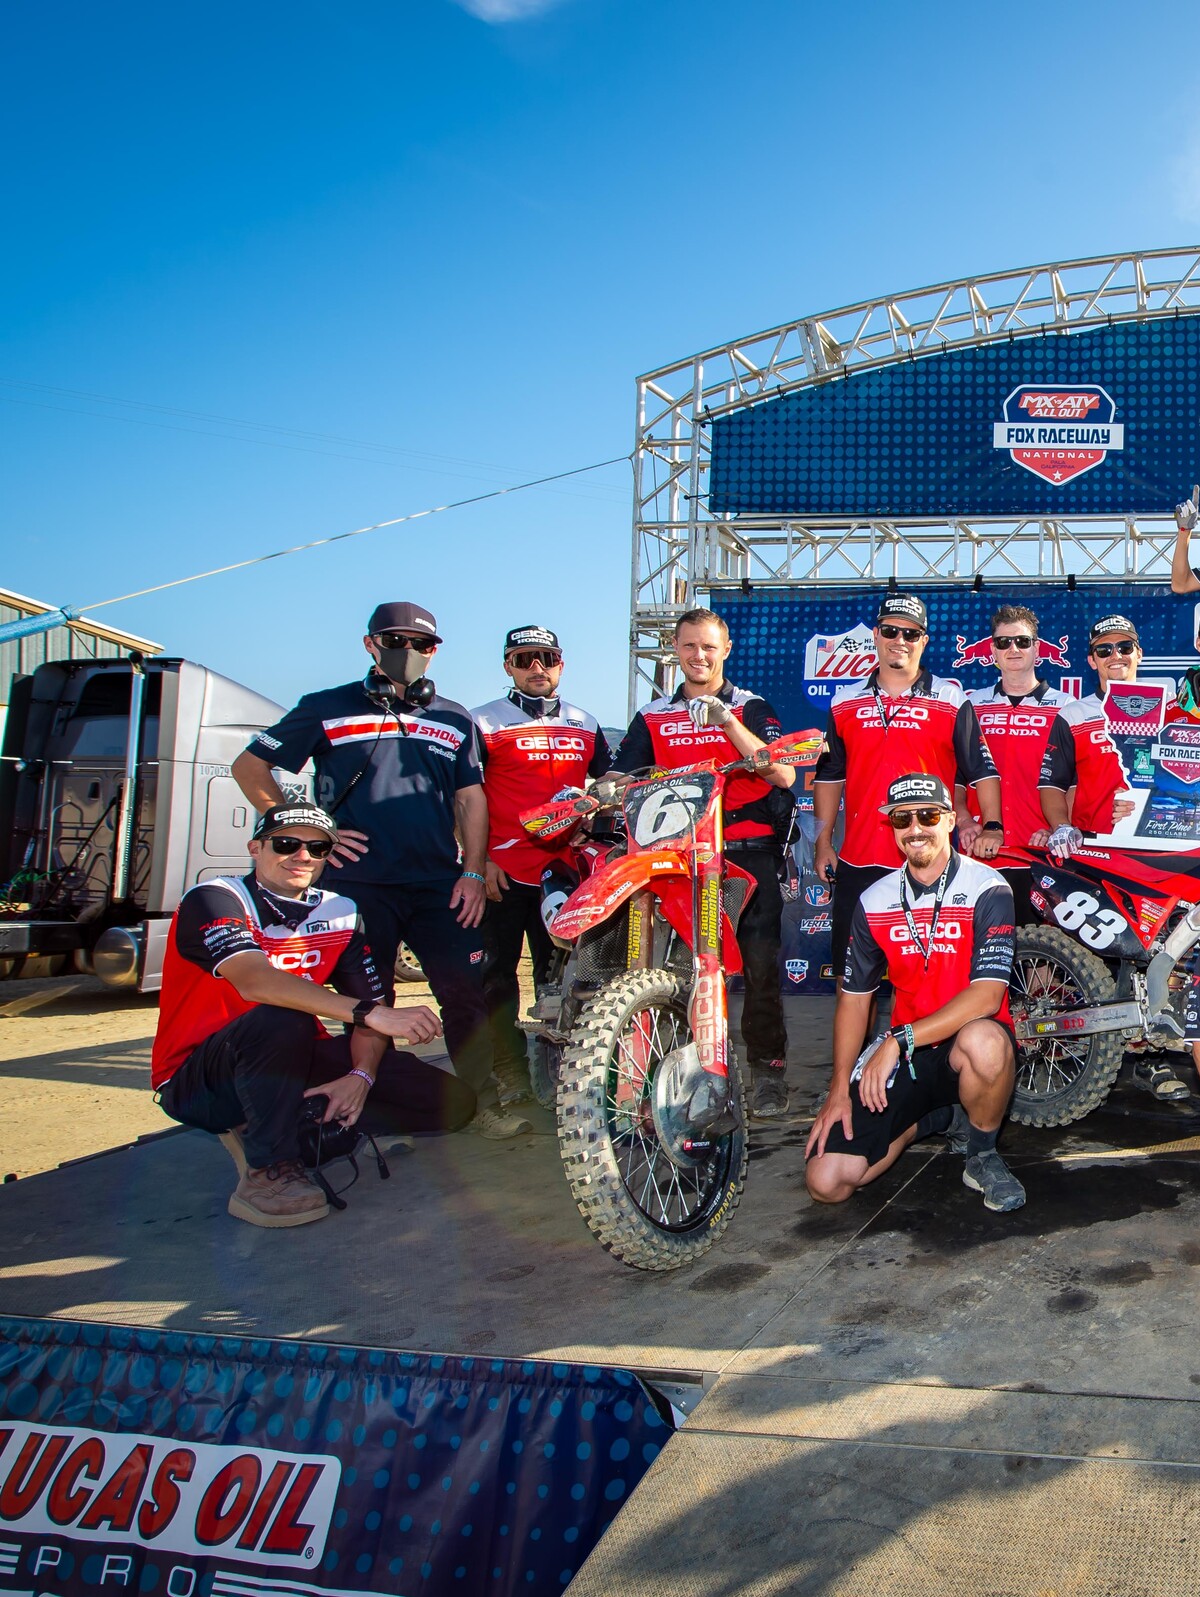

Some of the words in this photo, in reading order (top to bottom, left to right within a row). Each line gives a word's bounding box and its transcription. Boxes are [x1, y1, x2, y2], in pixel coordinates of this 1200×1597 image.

[1030, 408, 1056, 417] ALL
[1058, 408, 1083, 417] OUT
[1007, 428, 1035, 443] FOX
[1038, 428, 1110, 444] RACEWAY
[1022, 451, 1094, 459] NATIONAL
[885, 599, 923, 614] GEICO
[889, 606, 920, 618] HONDA
[1094, 618, 1131, 629] GEICO
[510, 629, 554, 643] GEICO
[517, 637, 552, 646] HONDA
[815, 653, 879, 677] LUC
[807, 685, 831, 696] OIL
[856, 705, 928, 720] GEICO
[862, 720, 921, 730] HONDA
[980, 713, 1047, 727] GEICO
[984, 727, 1040, 736] HONDA
[516, 736, 586, 751] GEICO
[668, 735, 727, 747] HONDA
[527, 752, 583, 761] HONDA
[1159, 748, 1176, 758] FOX
[642, 781, 669, 795] LUCAS
[669, 778, 684, 787] OIL
[889, 780, 936, 796] GEICO
[894, 789, 933, 800] HONDA
[274, 808, 333, 828] GEICO
[282, 816, 330, 829] HONDA
[635, 785, 703, 847] 6
[1145, 820, 1168, 830] First
[1168, 821, 1192, 832] Place
[553, 906, 605, 924] GEICO
[701, 888, 709, 937] Factory
[707, 879, 718, 948] Connection
[1053, 891, 1128, 949] 83
[889, 921, 962, 942] GEICO
[901, 944, 957, 955] HONDA
[695, 976, 715, 1067] GEICO
[195, 1453, 326, 1556] OIL
